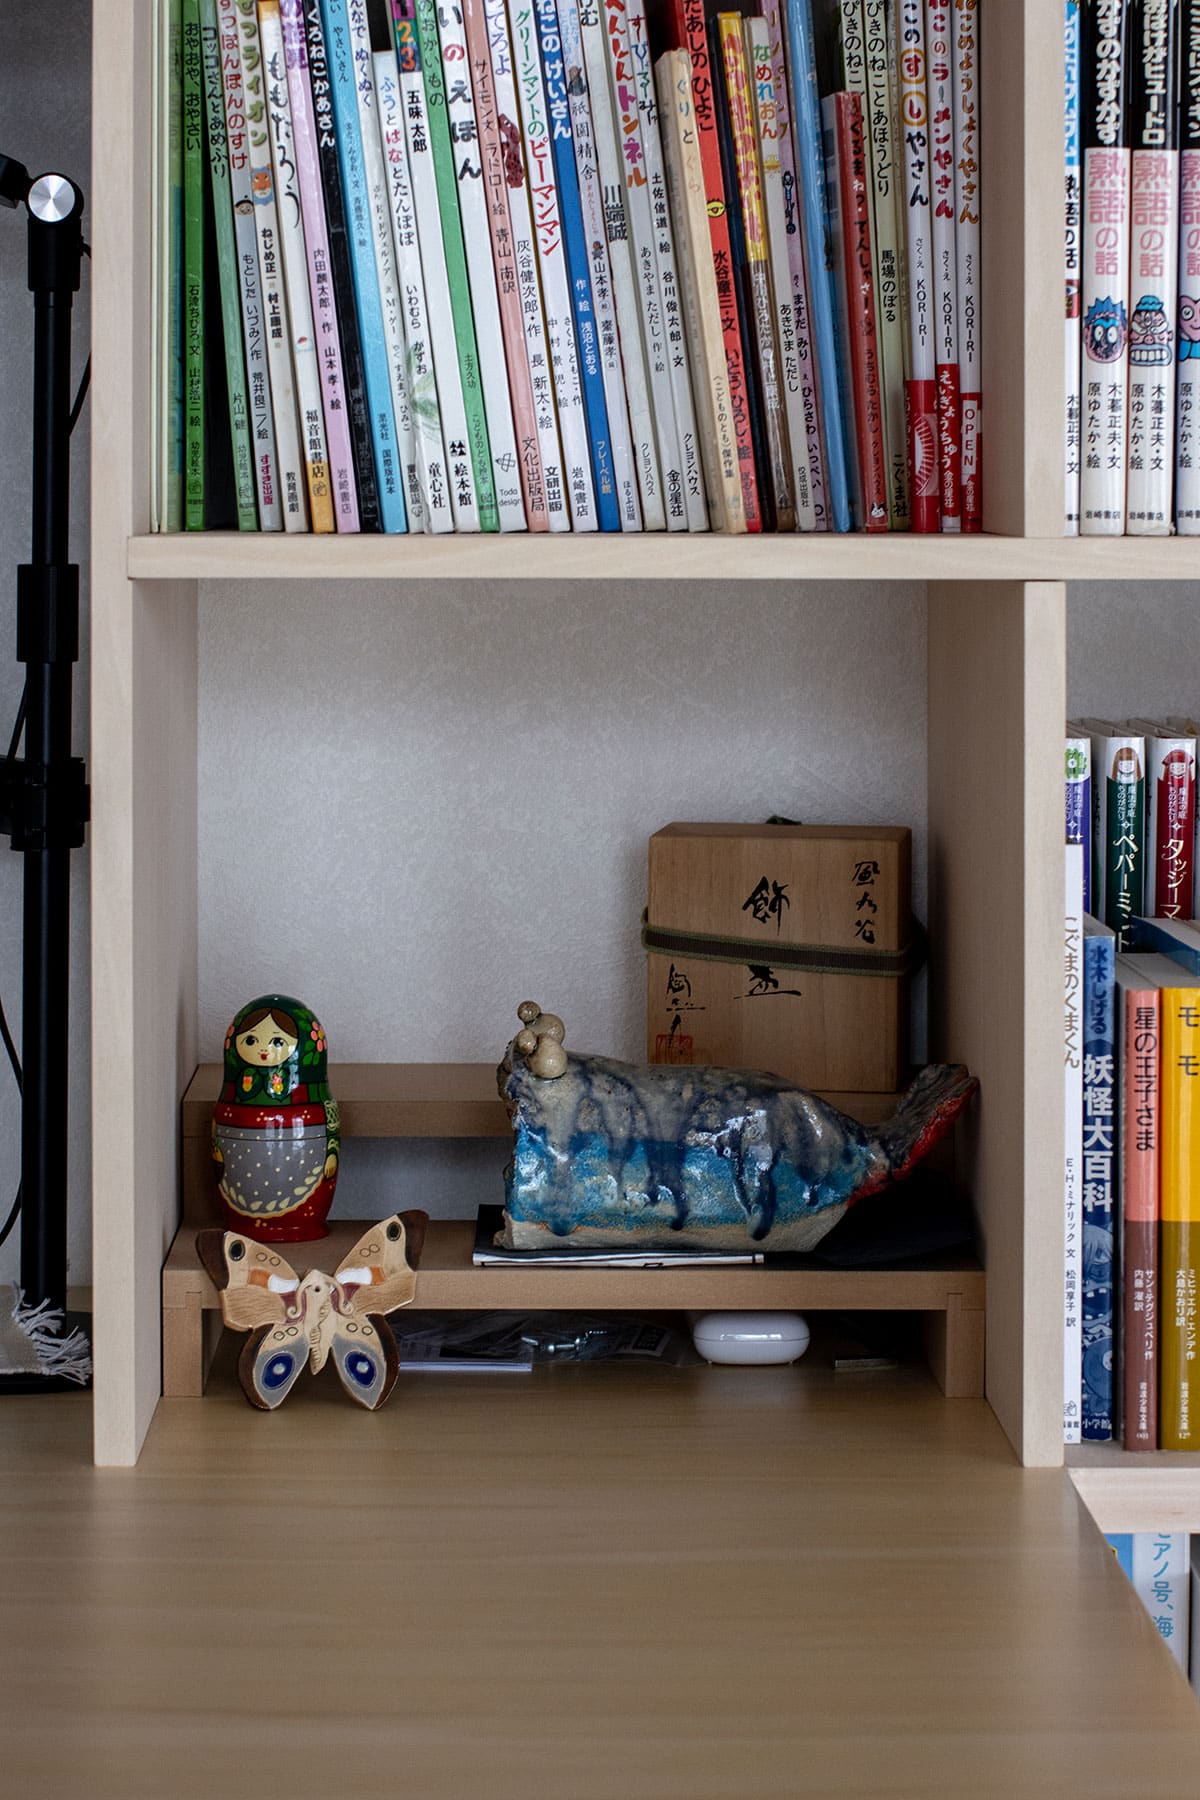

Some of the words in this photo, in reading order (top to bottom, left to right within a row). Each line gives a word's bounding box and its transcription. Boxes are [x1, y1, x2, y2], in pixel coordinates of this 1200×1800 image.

[202, 26, 230, 179] コッコさんとあめふり
[306, 8, 337, 148] くろねこかあさん
[355, 47, 374, 109] ぬくぬく
[753, 44, 778, 140] なめれおん
[266, 51, 301, 229] ももたろう
[380, 77, 416, 247] ふうとはなとたんぽぽ
[514, 9, 562, 256] グリーンマントのピーマンマン
[676, 79, 702, 194] ぐりとぐら
[604, 184, 629, 243] 川端誠
[651, 172, 672, 254] 土佐信道・絵
[1087, 151, 1127, 277] 熟語の話
[1132, 153, 1173, 278] 熟語の話
[260, 227, 278, 281] ねじめ正一
[640, 246, 656, 297] あきやま
[880, 250, 899, 323] 馬場のぼる
[406, 284, 422, 330] いわむら
[516, 239, 542, 340] 灰谷健次郎・作
[646, 301, 661, 338] ただし
[661, 270, 685, 368] 谷川俊太郎・文
[793, 293, 808, 330] ますだ
[916, 279, 928, 347] KORIRI
[413, 340, 428, 375] かずお
[780, 303, 796, 351] あきやま
[797, 336, 810, 362] みり
[941, 291, 954, 359] KORIRI
[964, 295, 976, 363] KORIRI
[785, 356, 800, 393] ただし
[305, 410, 326, 479] 福音館書店
[802, 387, 818, 435] ひらさわ
[962, 408, 977, 467] OPEN
[1086, 381, 1102, 470] 原ゆたか・絵
[1129, 383, 1146, 471] 原ゆたか・絵
[1178, 381, 1194, 470] 原ゆたか・絵
[428, 462, 447, 509] 童心社
[454, 464, 473, 508] 絵本館
[522, 436, 546, 513] 文化出版局
[544, 466, 564, 513] 文研出版
[572, 466, 589, 518] 岩崎書店
[596, 441, 613, 495] フレーベル館
[640, 442, 656, 497] クレヨンハウス
[666, 469, 685, 518] 金の星社
[682, 432, 701, 497] クレヨンハウス
[893, 453, 909, 518] こぐま社
[1064, 916, 1081, 1069] こぐまのくまくん
[1089, 945, 1109, 1036] 水木しげる
[1133, 1006, 1158, 1152] 星の王子さま
[1083, 1054, 1114, 1213] 妖怪大百科
[1082, 1418, 1111, 1430] 小学館
